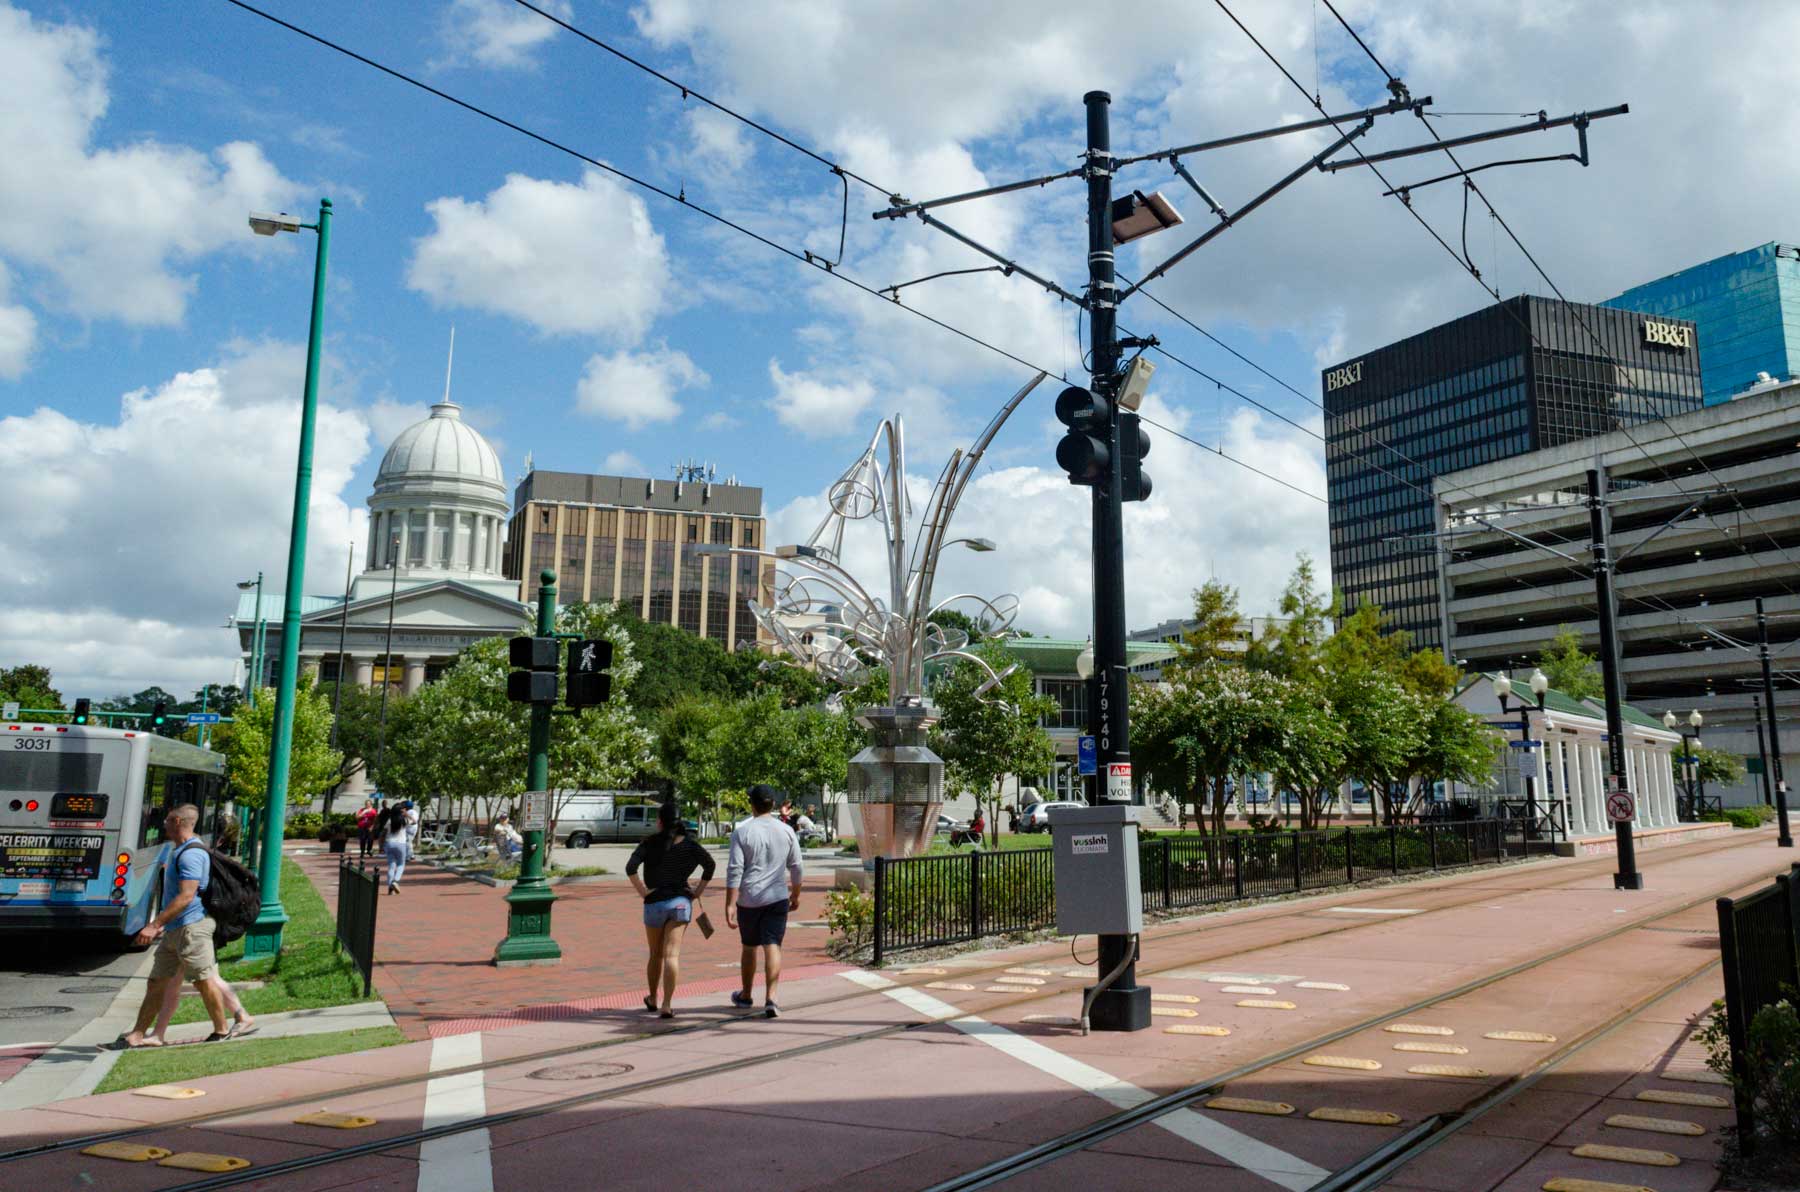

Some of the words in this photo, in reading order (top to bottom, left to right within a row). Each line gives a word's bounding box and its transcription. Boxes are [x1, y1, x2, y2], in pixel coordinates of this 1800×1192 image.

[1644, 320, 1693, 348] BB&T
[1326, 360, 1364, 392] BB&T
[1100, 669, 1110, 751] 179+40
[14, 738, 51, 751] 3031
[53, 837, 102, 849] WEEKEND
